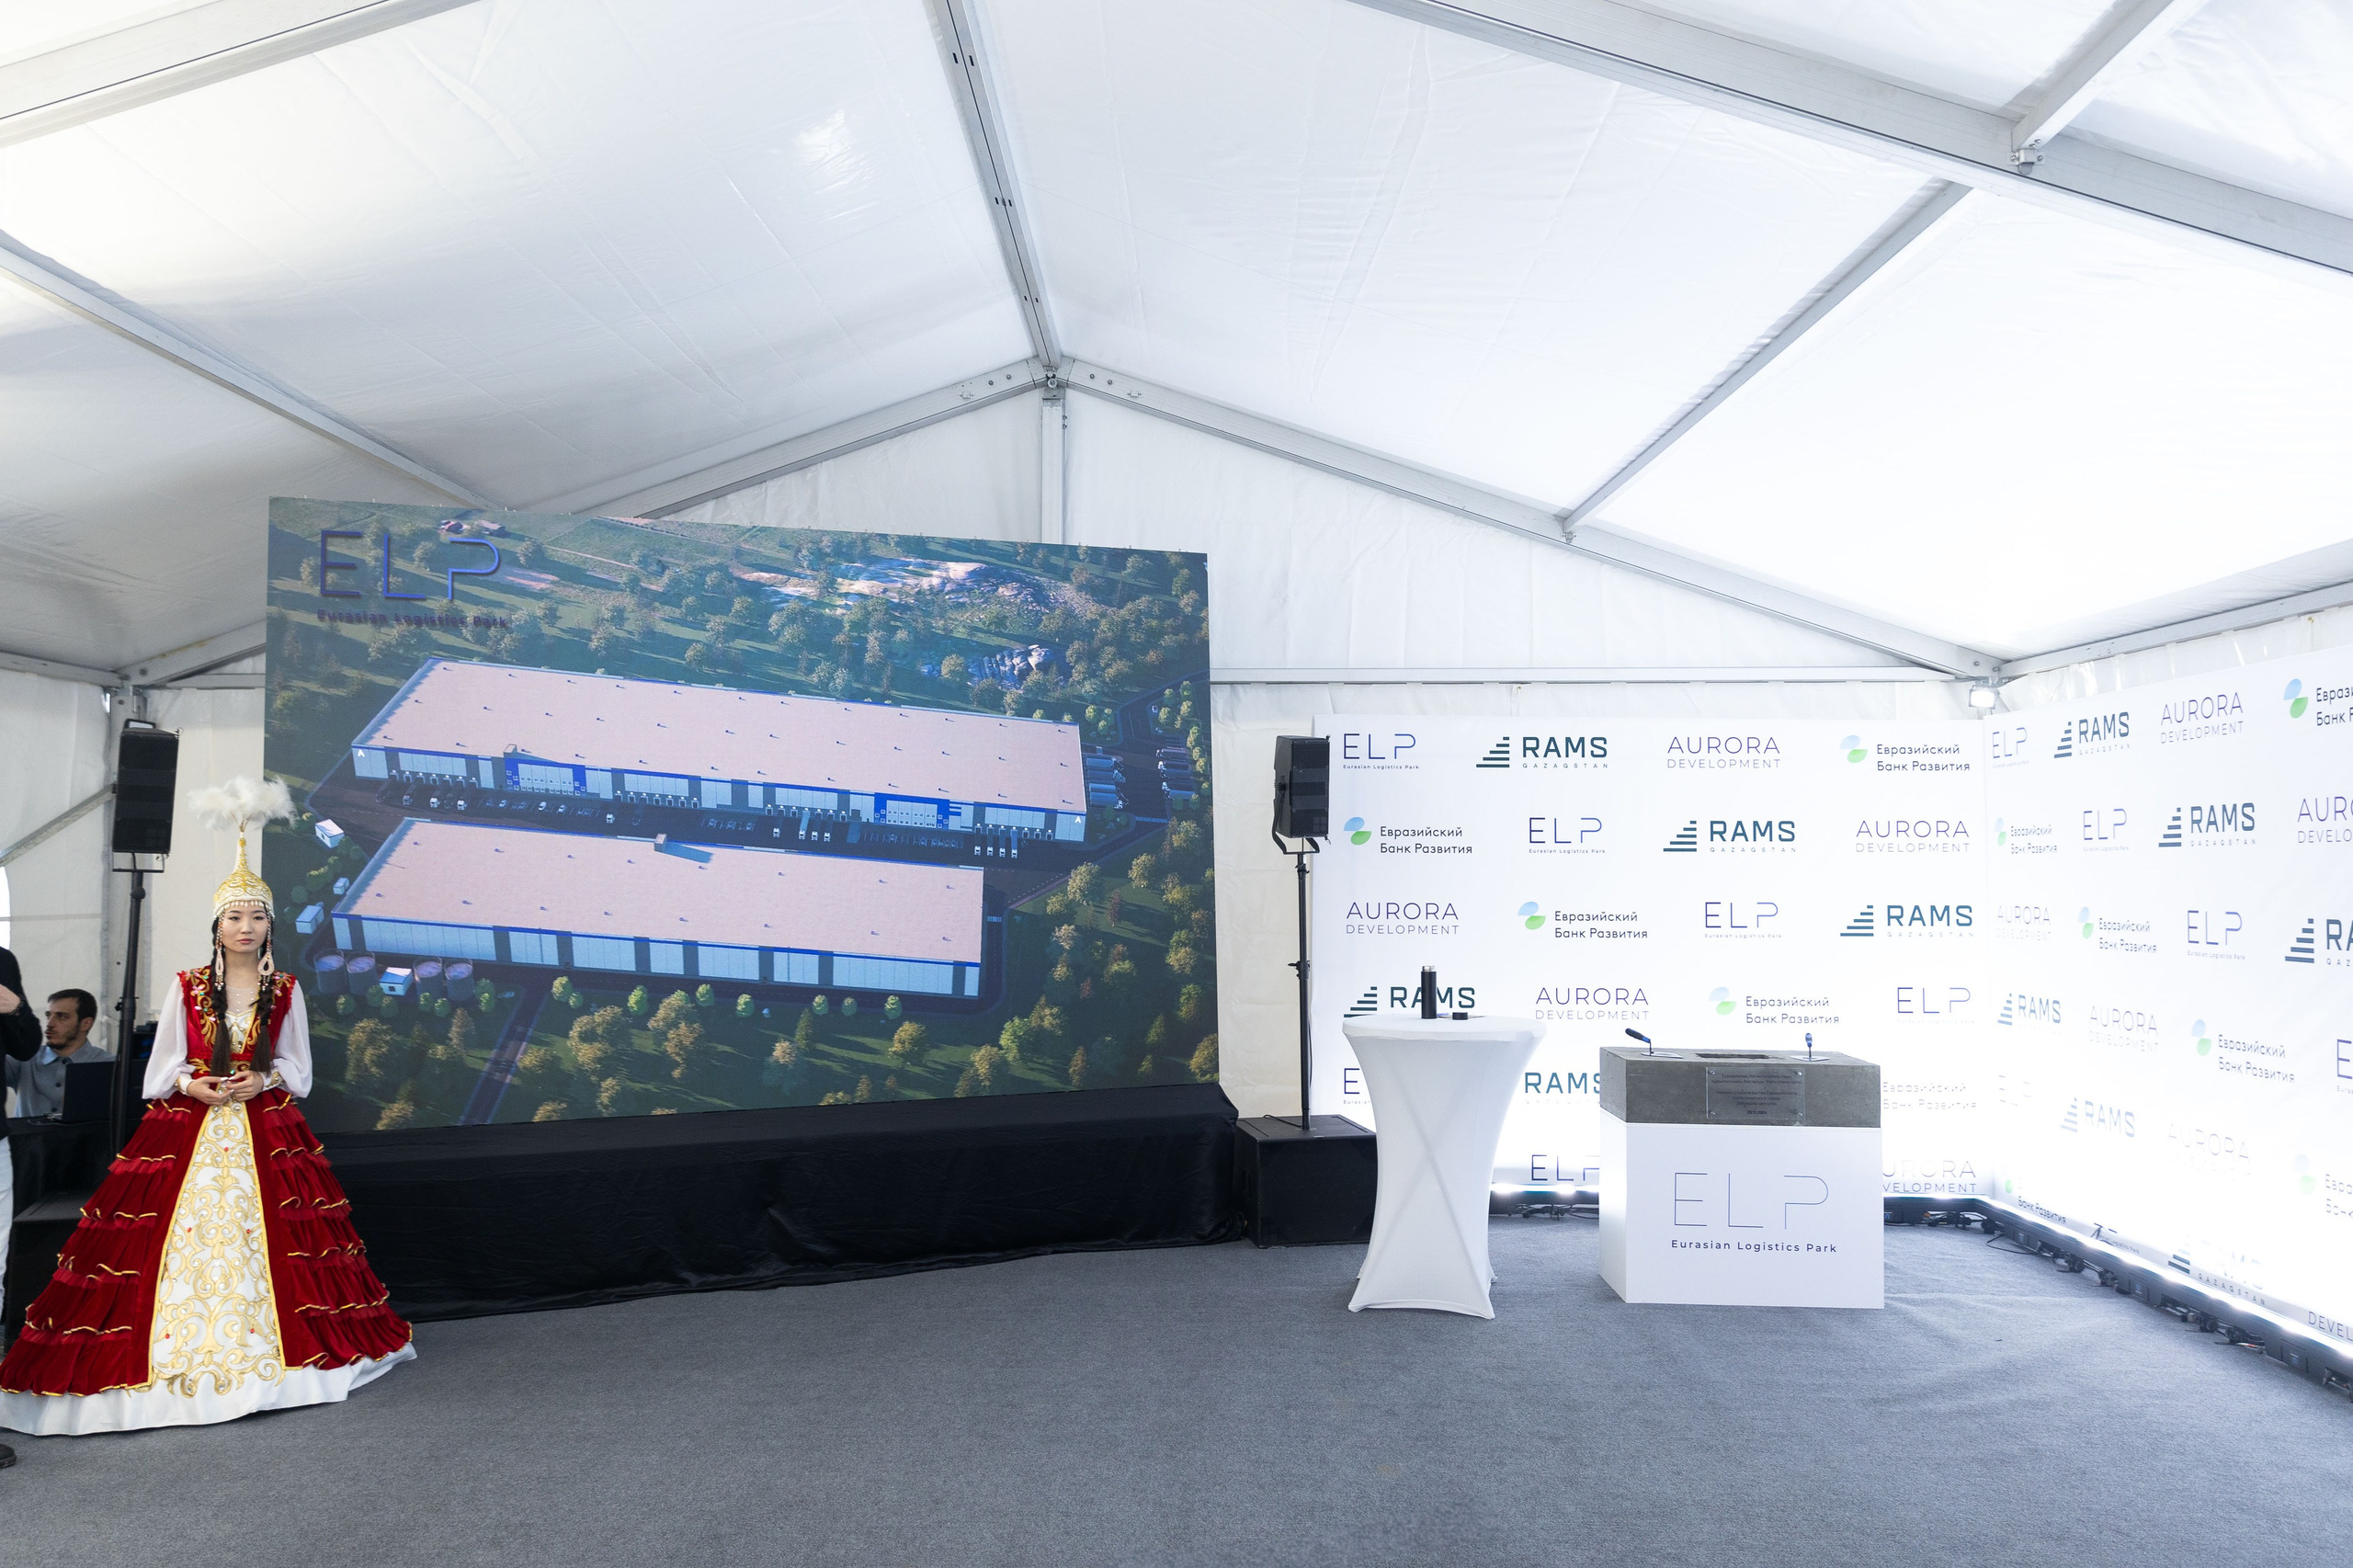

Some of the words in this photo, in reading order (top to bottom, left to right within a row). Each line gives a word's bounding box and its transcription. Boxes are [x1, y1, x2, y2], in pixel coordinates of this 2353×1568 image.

[321, 530, 500, 600] ELP
[317, 609, 387, 623] Eurasian
[394, 613, 467, 627] Logistics
[473, 616, 507, 627] Park
[2161, 692, 2244, 725] AURORA
[2316, 710, 2346, 727] Банк
[2079, 711, 2130, 744] RAMS
[2161, 721, 2244, 744] DEVELOPMENT
[1343, 733, 1416, 760] ELP
[1522, 736, 1608, 758] RAMS
[1666, 736, 1780, 755] AURORA
[1877, 744, 1960, 756] Евразийский
[1992, 726, 2027, 759] ELP
[1666, 758, 1781, 769] DEVELOPMENT
[1877, 760, 1908, 772] Банк
[1912, 760, 1971, 772] Развития
[2190, 801, 2256, 834] RAMS
[2297, 795, 2353, 823] AUR
[1381, 825, 1462, 839] Евразийский
[1529, 817, 1603, 844] ELP
[1710, 820, 1796, 843] RAMS
[1856, 820, 1970, 838] AURORA
[2083, 808, 2127, 841] ELP
[2297, 828, 2353, 844] DEVELO
[1380, 842, 1412, 854] Банк
[1415, 843, 1472, 854] Развития
[1856, 842, 1971, 853] DEVELOPMENT
[1346, 901, 1459, 920] AURORA
[1554, 910, 1638, 925] Евразийский
[1704, 902, 1779, 929] ELP
[1886, 904, 1973, 927] RAMS
[1996, 905, 2052, 926] AURORA
[1346, 924, 1460, 935] DEVELOPMENT
[1554, 927, 1586, 938] Банк
[1589, 927, 1648, 938] Развития
[2098, 917, 2150, 932] Евразийский
[2187, 909, 2243, 946] ELP
[2099, 937, 2118, 950] Банк
[2120, 938, 2157, 952] Развития
[1535, 986, 1649, 1006] AURORA
[1745, 995, 1829, 1010] Евразийский
[1896, 986, 1971, 1014] ELP
[1535, 1009, 1650, 1020] DEVELOPMENT
[1745, 1012, 1778, 1024] Банк
[1781, 1013, 1839, 1024] Развития
[2018, 994, 2062, 1024] RAMS
[2089, 1006, 2158, 1036] AURORA
[2218, 1033, 2286, 1060] Евразийский
[2219, 1056, 2243, 1073] Банк
[2245, 1061, 2295, 1083] Развития
[2085, 1099, 2135, 1139] RAMS
[1882, 1160, 1976, 1177] URORA
[1882, 1182, 1977, 1193] VELOPMENT
[1674, 1172, 1829, 1230] ELP
[1671, 1239, 1731, 1250] Eurasian
[1737, 1241, 1800, 1253] Logistics
[1806, 1243, 1837, 1253] Park
[2199, 1272, 2267, 1306] QAZAQSTAN
